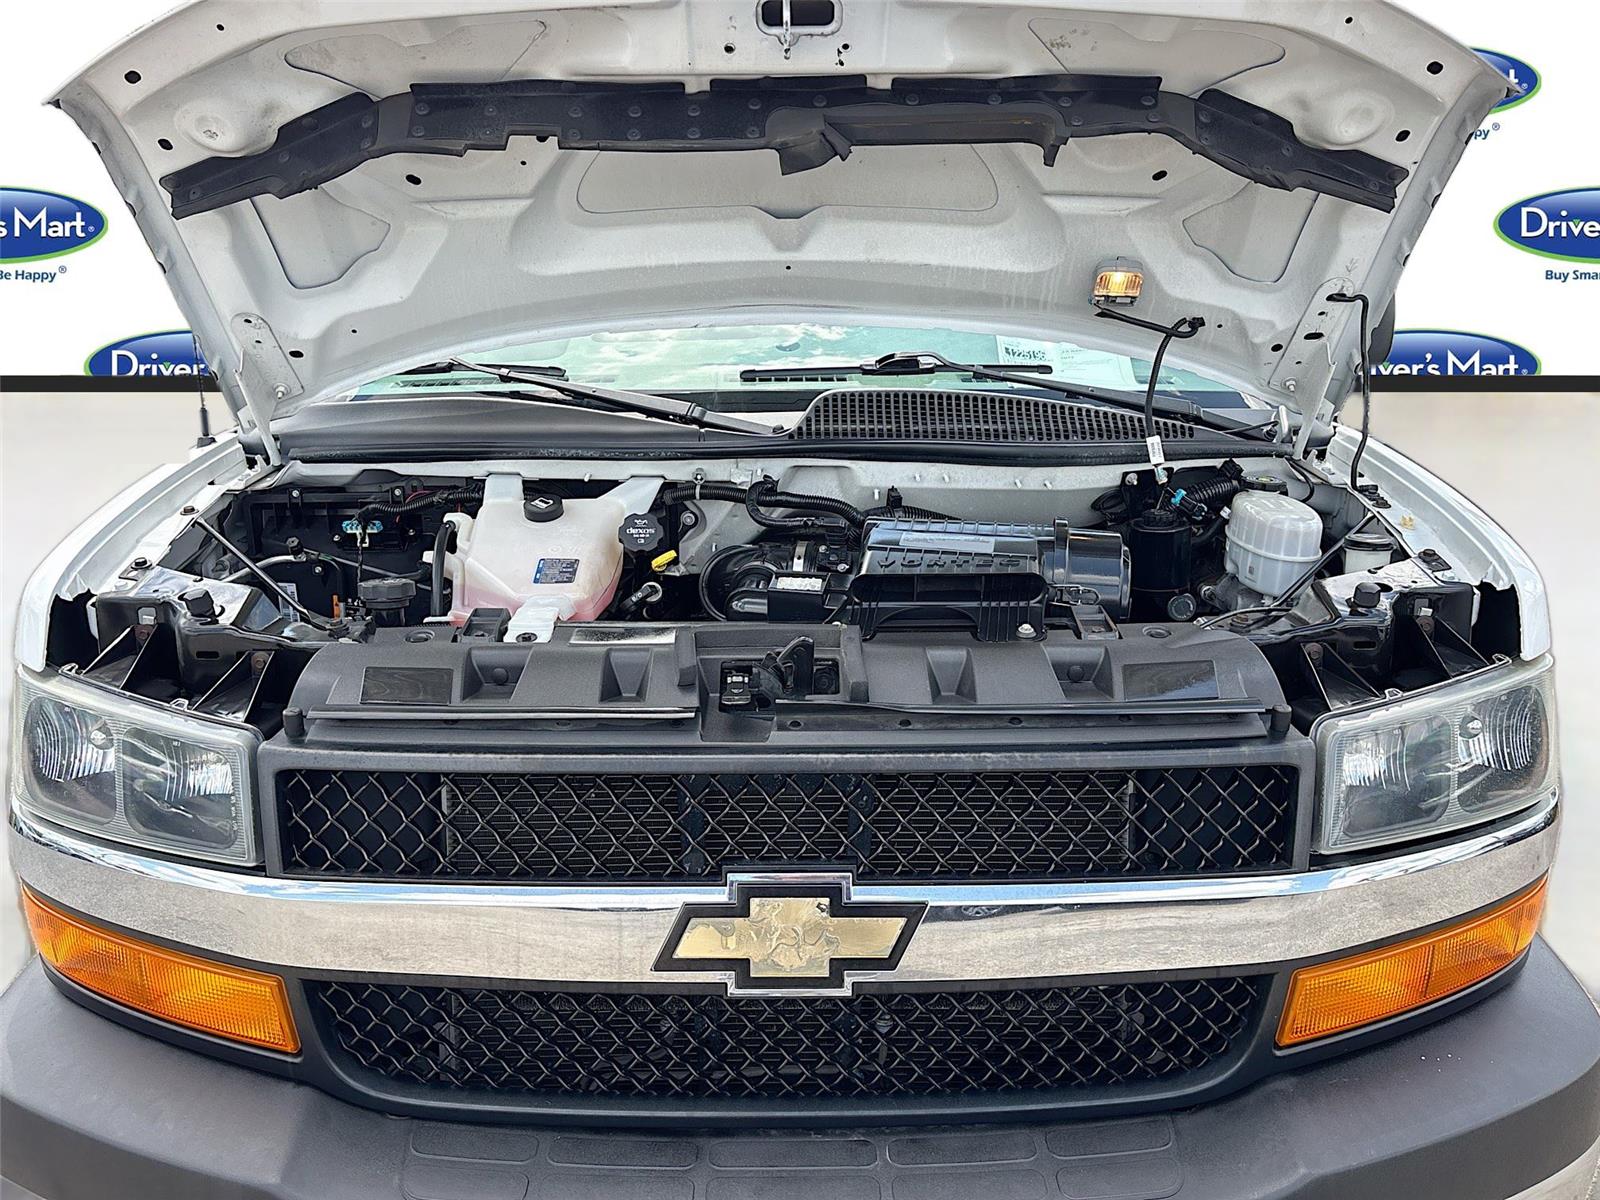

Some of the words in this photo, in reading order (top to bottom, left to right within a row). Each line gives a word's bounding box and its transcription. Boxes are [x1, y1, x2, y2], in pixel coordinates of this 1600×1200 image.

[14, 206, 86, 237] Mart
[15, 269, 57, 283] Happy
[1545, 269, 1570, 283] Buy
[1572, 269, 1600, 280] Sma
[111, 349, 206, 376] Driver
[1370, 352, 1441, 376] iver's
[1447, 349, 1519, 376] Mart
